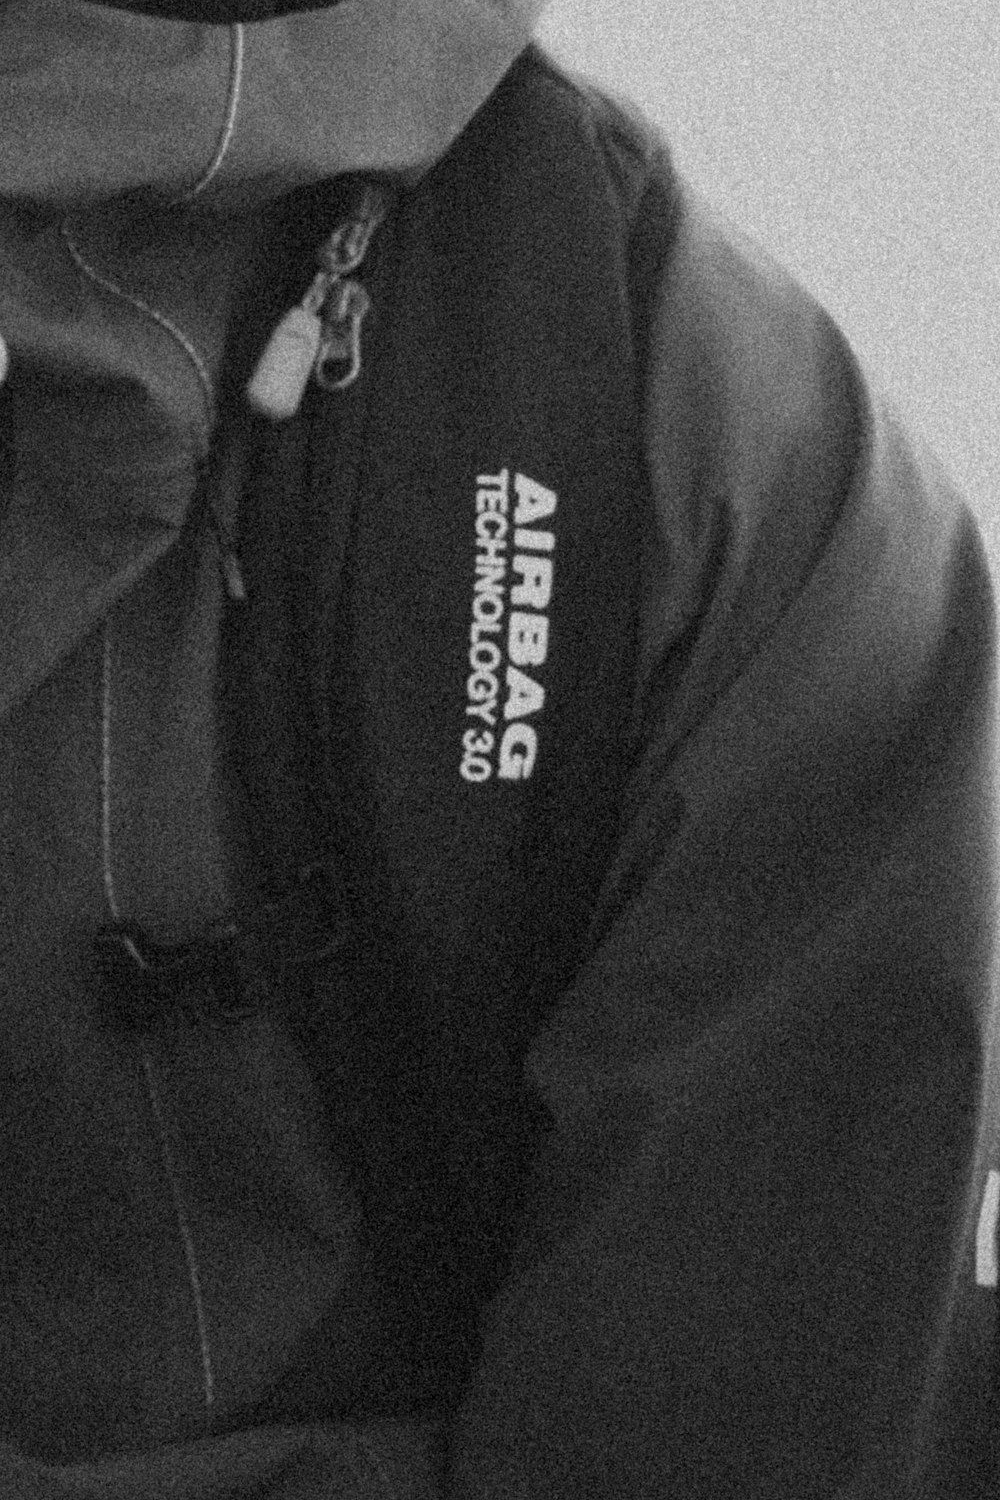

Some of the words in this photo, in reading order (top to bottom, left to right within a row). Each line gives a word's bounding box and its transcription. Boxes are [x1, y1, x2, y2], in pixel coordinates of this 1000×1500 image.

[465, 468, 508, 726] TECHNOLOGY
[498, 471, 557, 780] AIRBAG
[459, 728, 495, 782] 3.0
